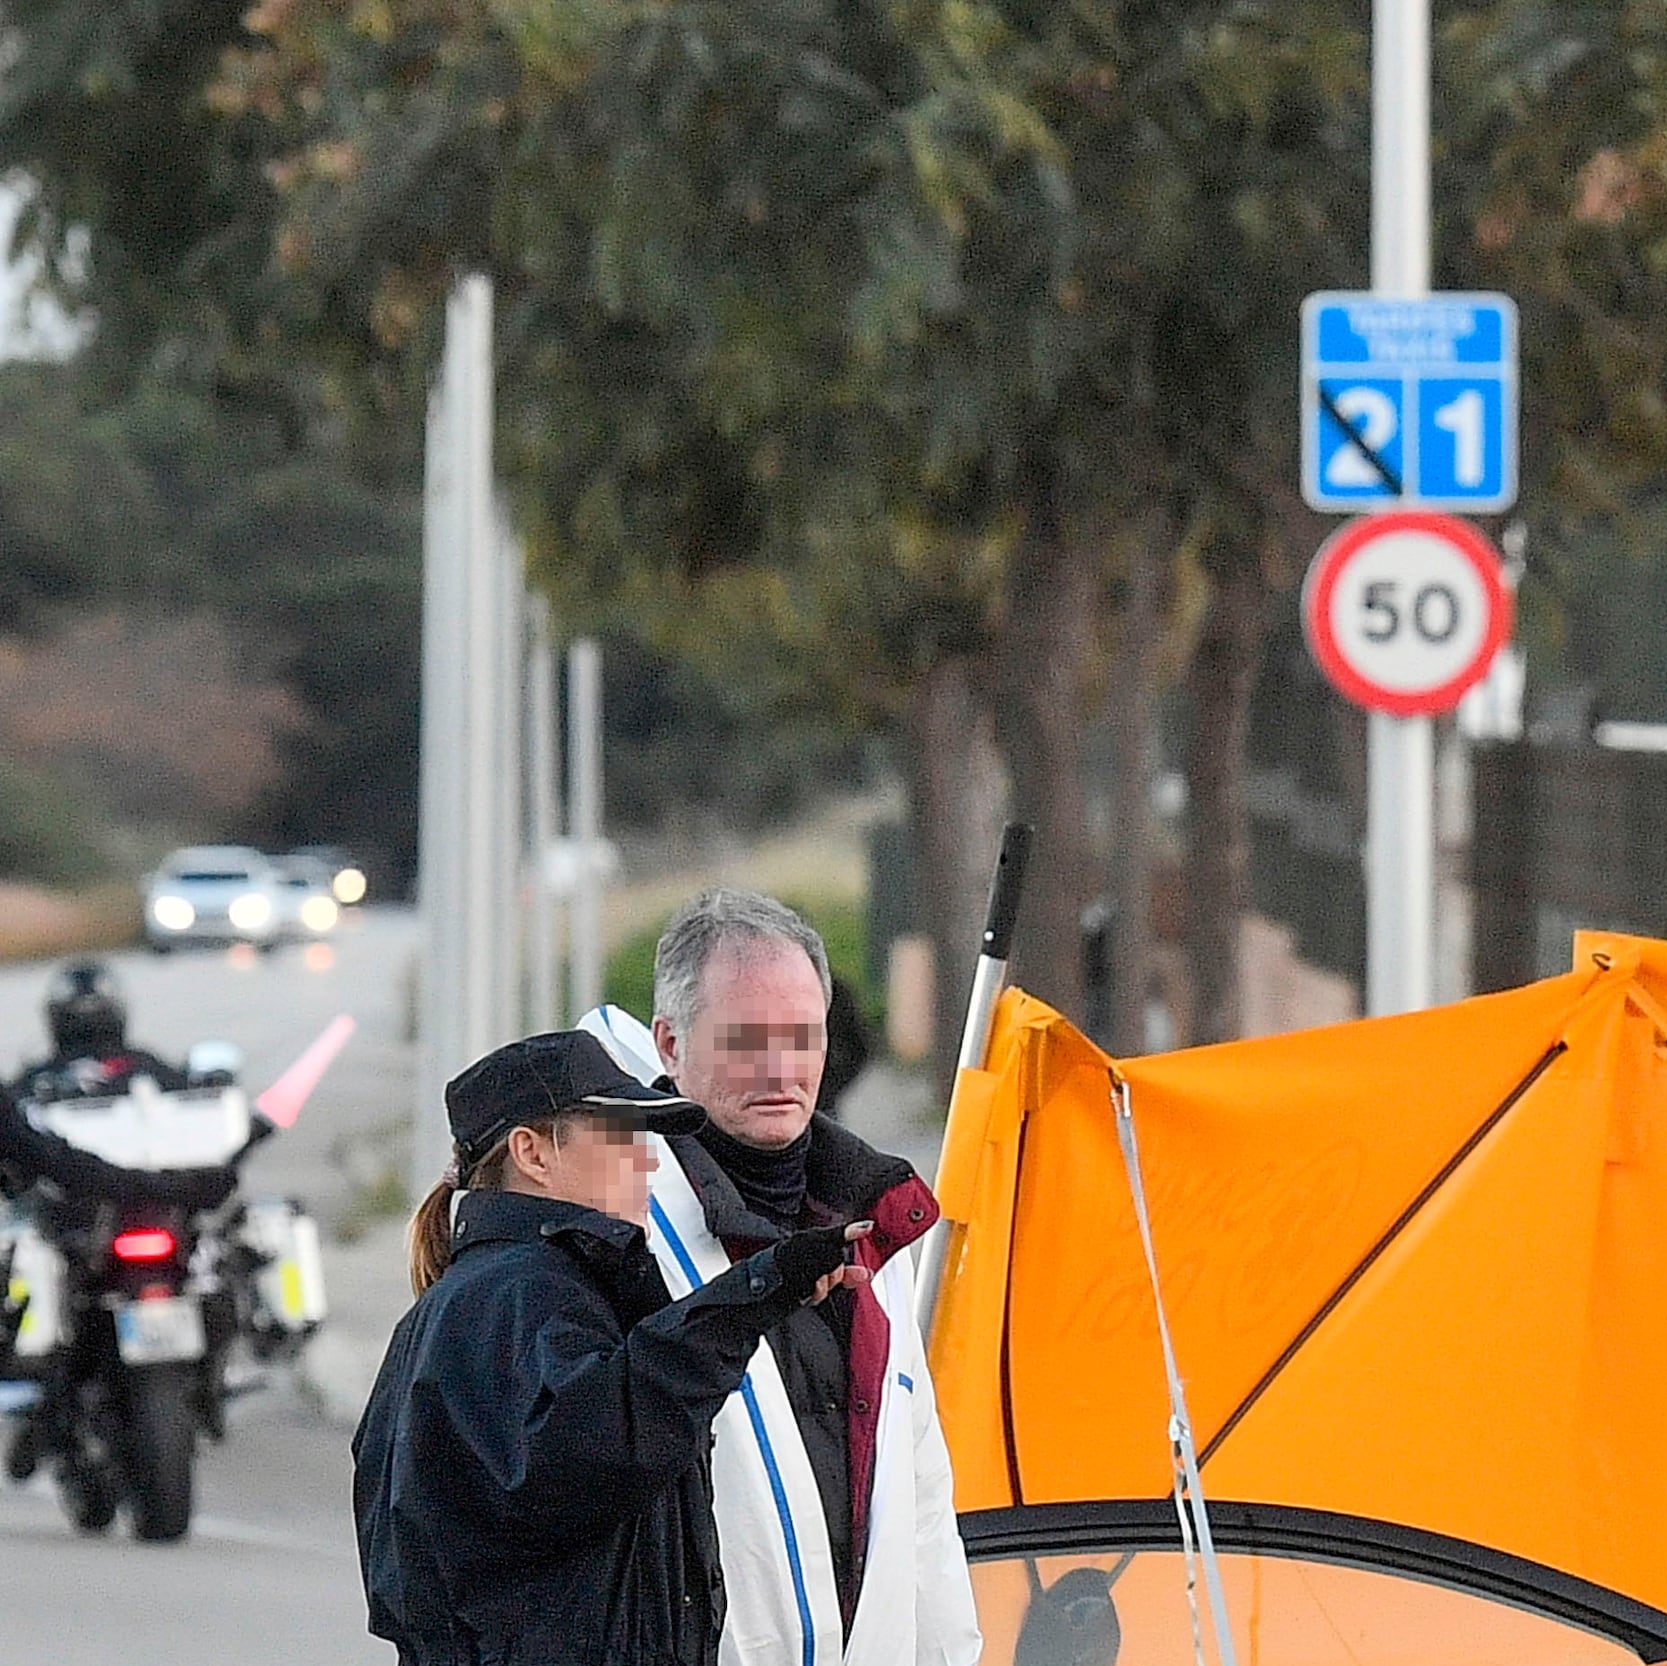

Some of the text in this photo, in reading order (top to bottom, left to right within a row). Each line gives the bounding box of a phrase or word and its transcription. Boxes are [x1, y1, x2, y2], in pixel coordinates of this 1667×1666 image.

[1325, 386, 1486, 488] 2 1
[1361, 581, 1460, 644] 50
